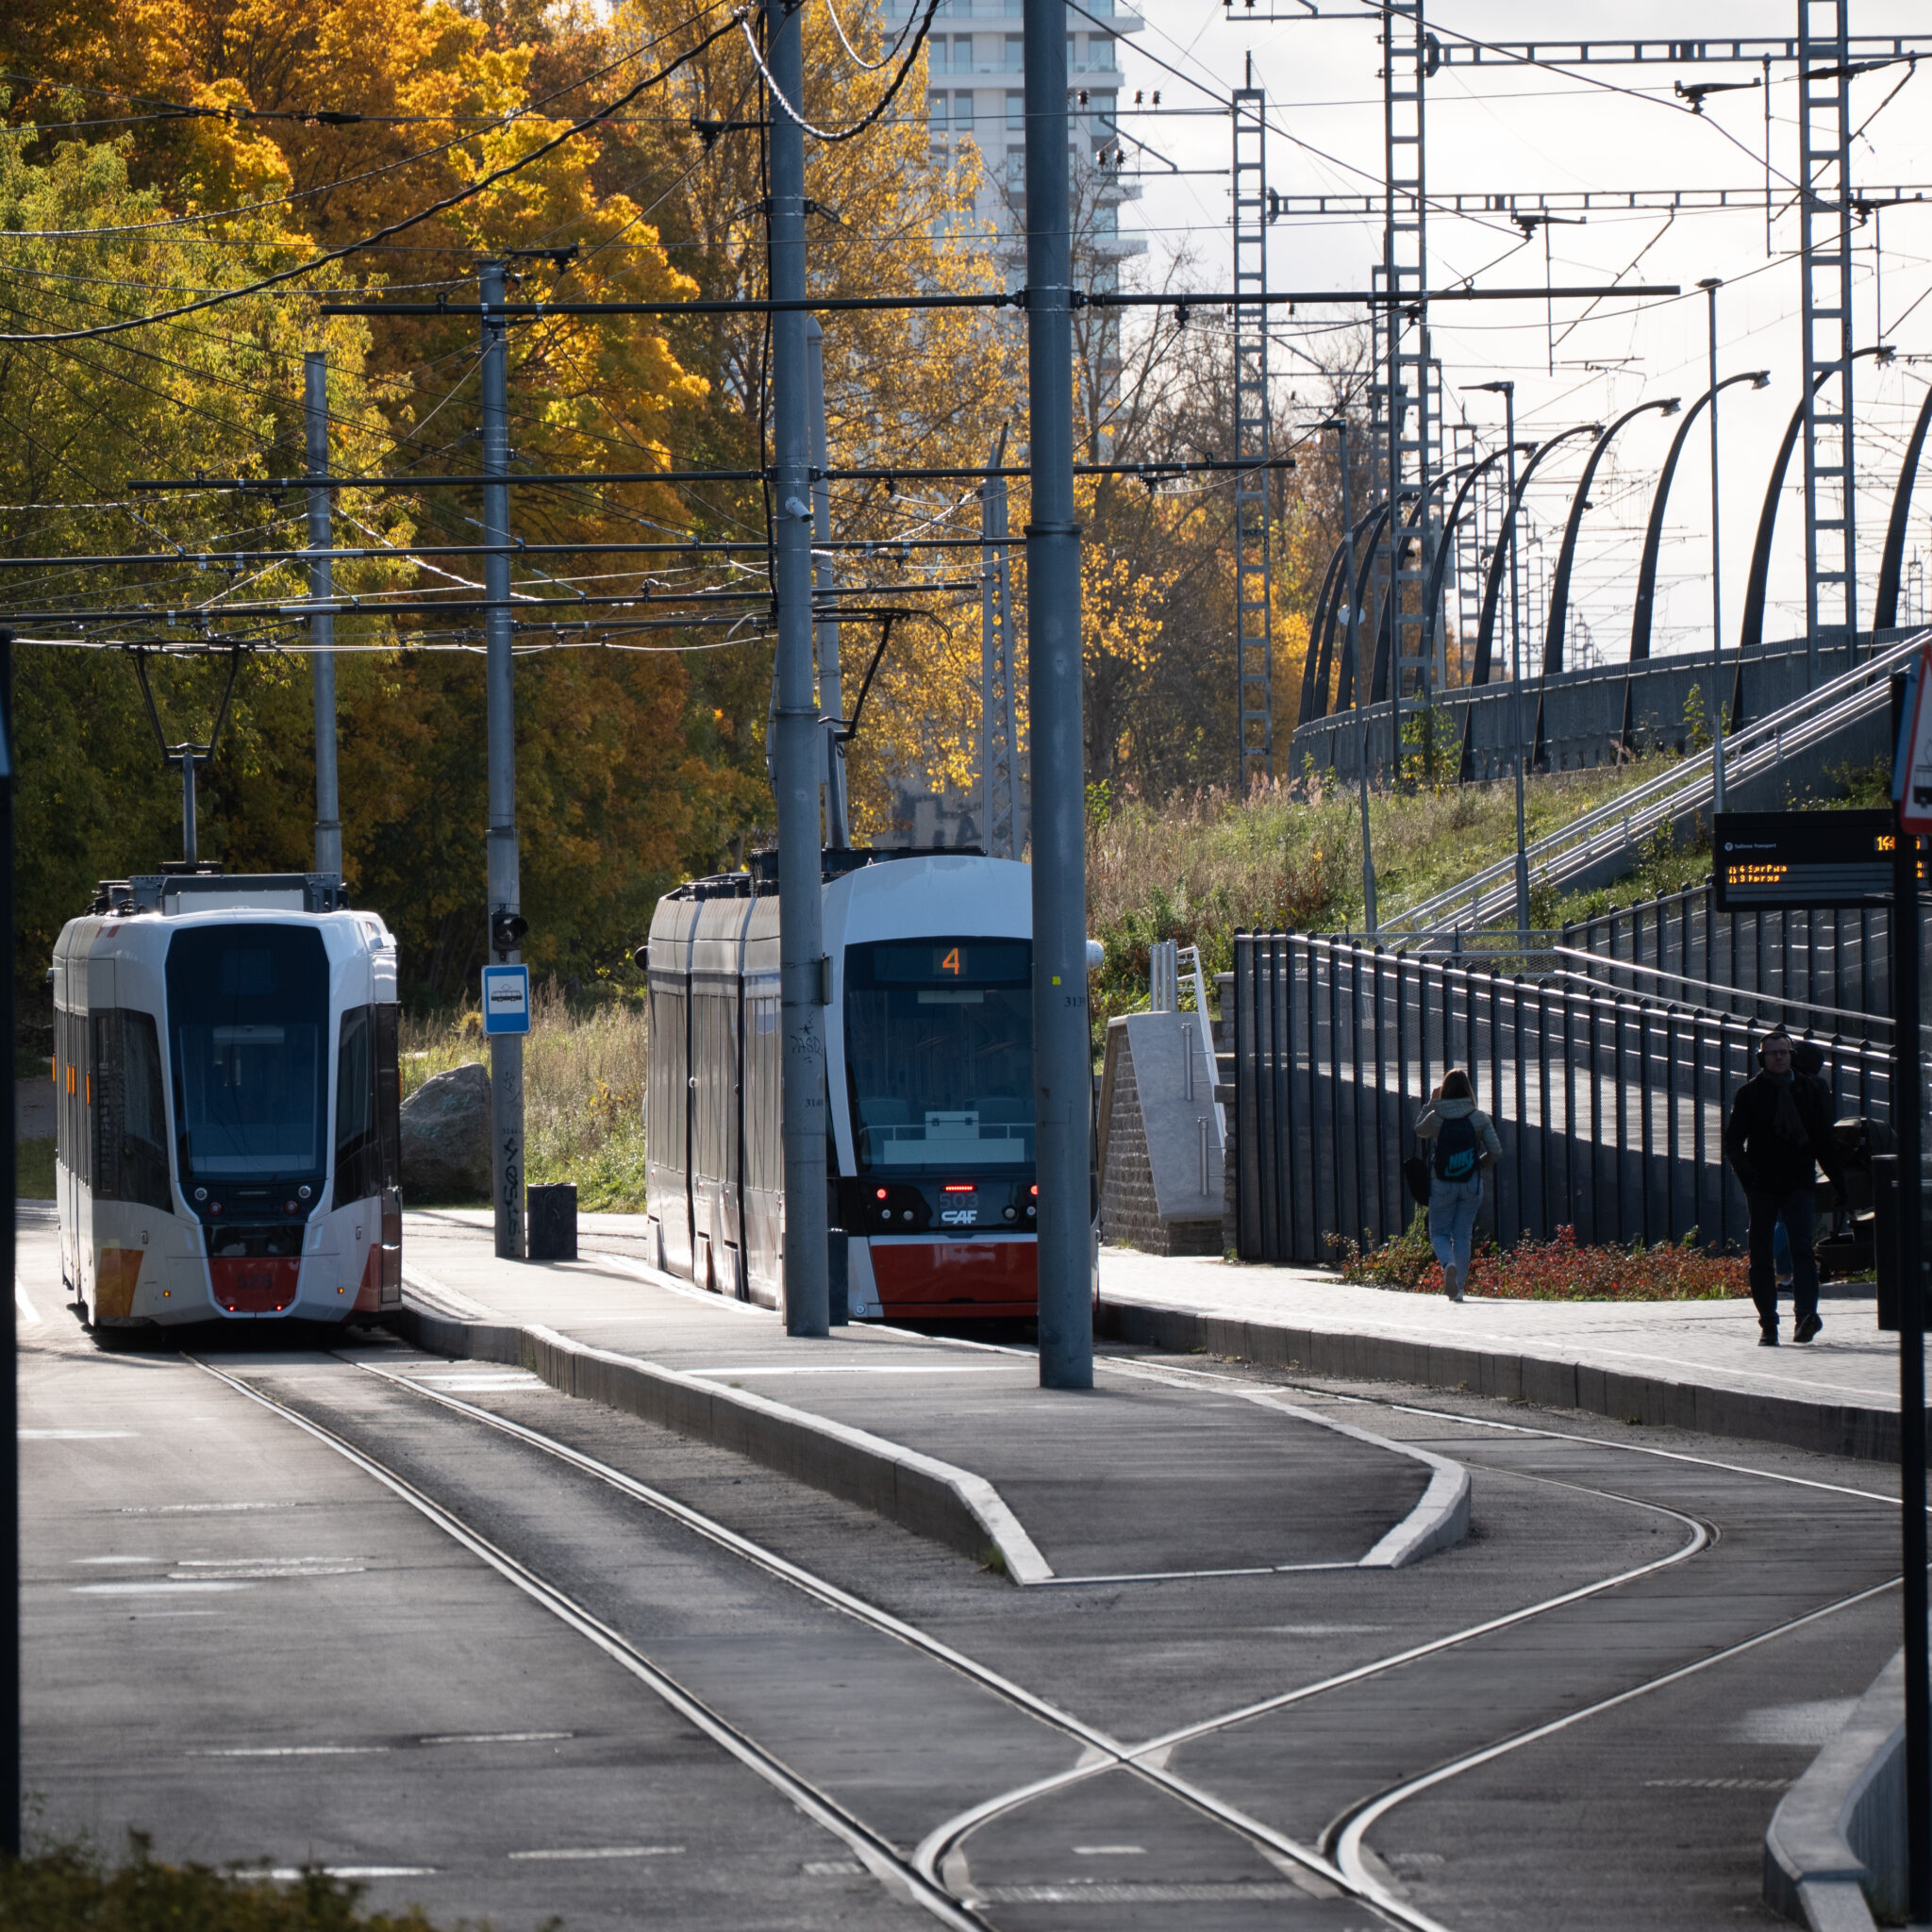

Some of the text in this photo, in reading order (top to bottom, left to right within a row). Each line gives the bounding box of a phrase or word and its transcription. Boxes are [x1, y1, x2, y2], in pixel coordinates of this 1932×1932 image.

[942, 947, 959, 974] 4
[1449, 1147, 1474, 1170] NIKE
[940, 1192, 979, 1208] 503
[941, 1210, 977, 1224] CAF
